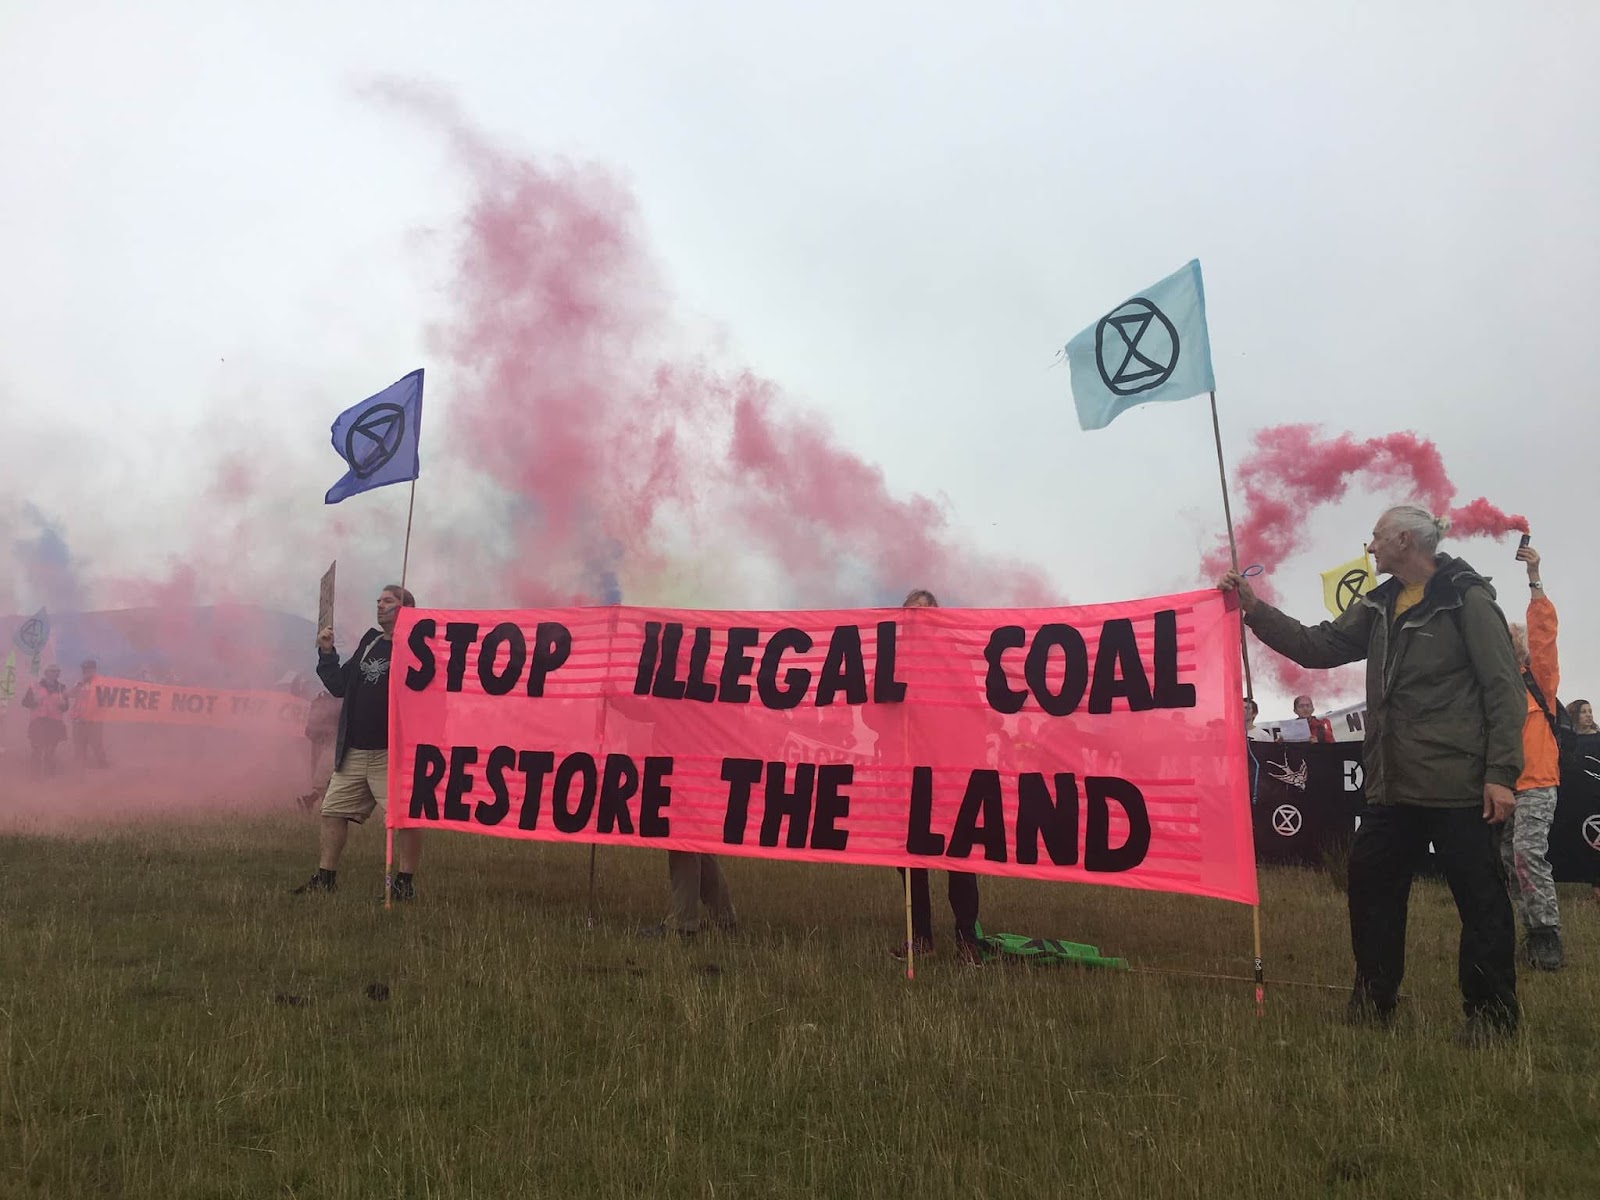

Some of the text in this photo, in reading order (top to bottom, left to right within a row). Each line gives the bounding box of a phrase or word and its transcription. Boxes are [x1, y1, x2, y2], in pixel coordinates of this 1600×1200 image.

[95, 685, 162, 711] WE'RE
[170, 692, 219, 716] NOT
[406, 610, 1196, 716] STOP ILLEGAL COAL
[409, 744, 1150, 872] RESTORE THE LAND
